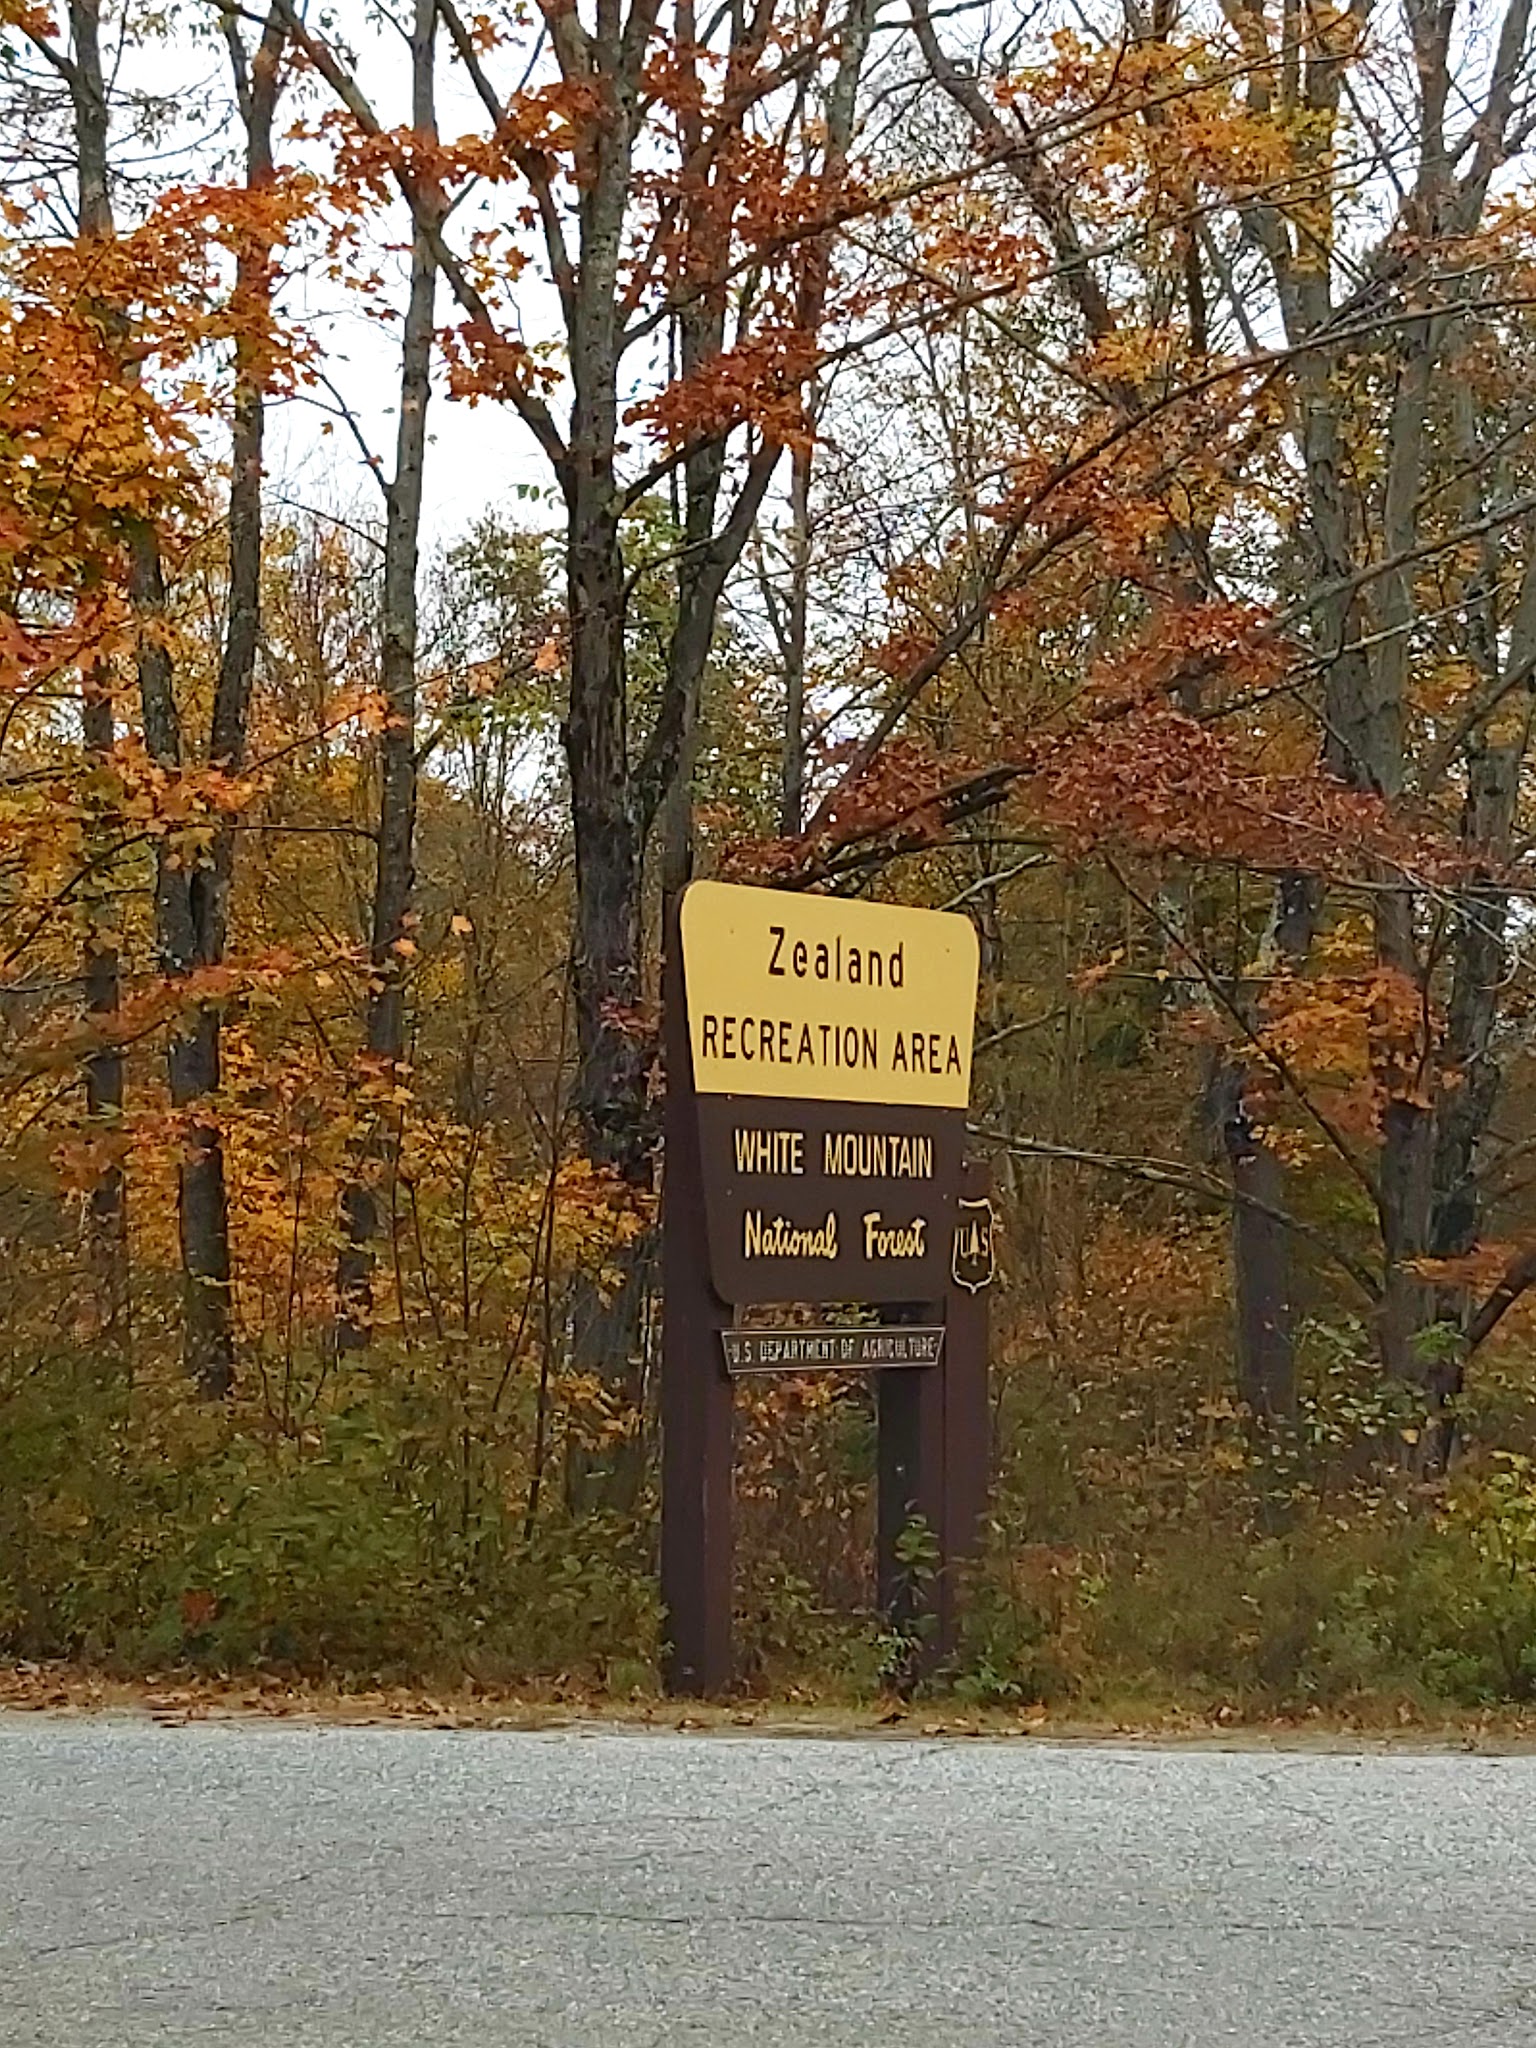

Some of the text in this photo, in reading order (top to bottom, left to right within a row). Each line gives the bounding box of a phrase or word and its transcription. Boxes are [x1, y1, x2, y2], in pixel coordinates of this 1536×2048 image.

[768, 926, 905, 988] Zealand
[702, 1014, 962, 1076] RECREATION AREA
[735, 1129, 932, 1178] WHITE MOUNTAIN
[743, 1210, 927, 1260] National Forest
[760, 1339, 837, 1361] DEPARTMENT
[841, 1339, 855, 1359] OF
[862, 1336, 935, 1357] AGRICULTURE
